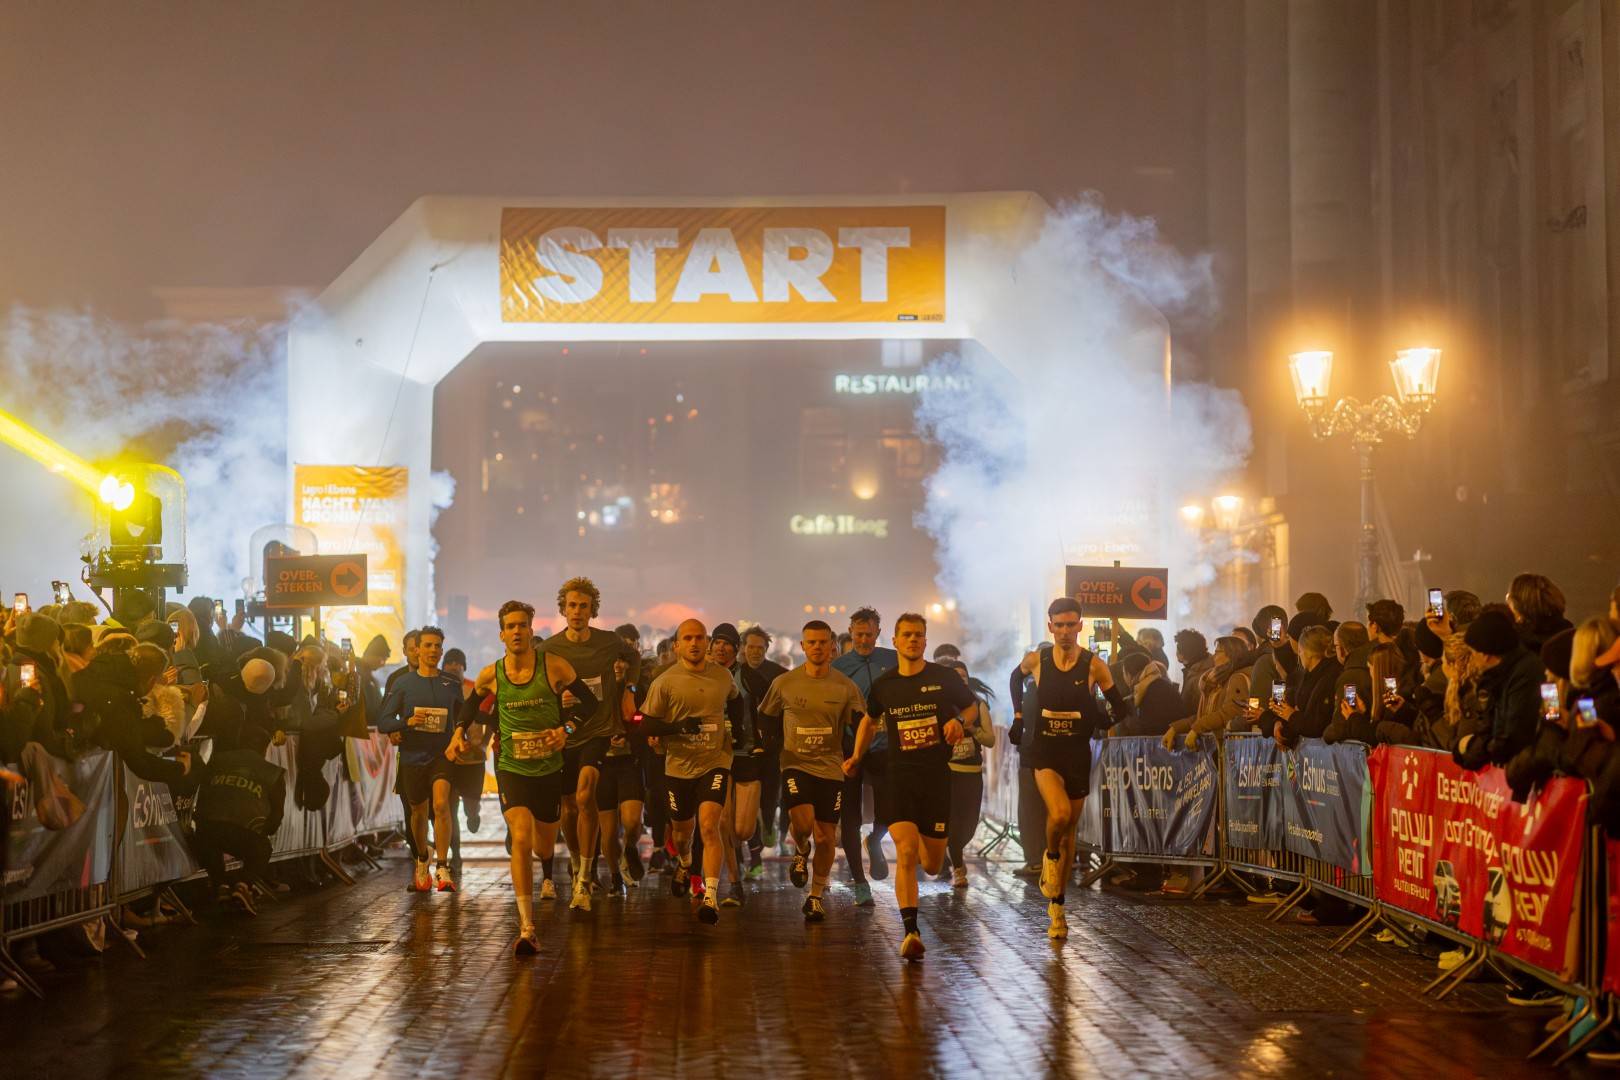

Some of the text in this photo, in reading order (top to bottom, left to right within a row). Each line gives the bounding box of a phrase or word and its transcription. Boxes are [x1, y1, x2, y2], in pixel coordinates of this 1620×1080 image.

[534, 226, 911, 304] START
[279, 569, 318, 582] OVER-
[275, 581, 323, 593] STEKEN
[1080, 580, 1120, 593] OVER-
[1075, 592, 1124, 605] STEKEN
[889, 706, 910, 716] Lagro
[914, 703, 937, 712] Ebens
[1048, 720, 1073, 729] 1961
[804, 735, 825, 745] 472
[903, 726, 934, 741] 3054
[521, 739, 543, 750] 294
[1135, 754, 1173, 791] Ebens
[1302, 756, 1326, 794] Eshuis
[210, 774, 263, 799] MEDIA
